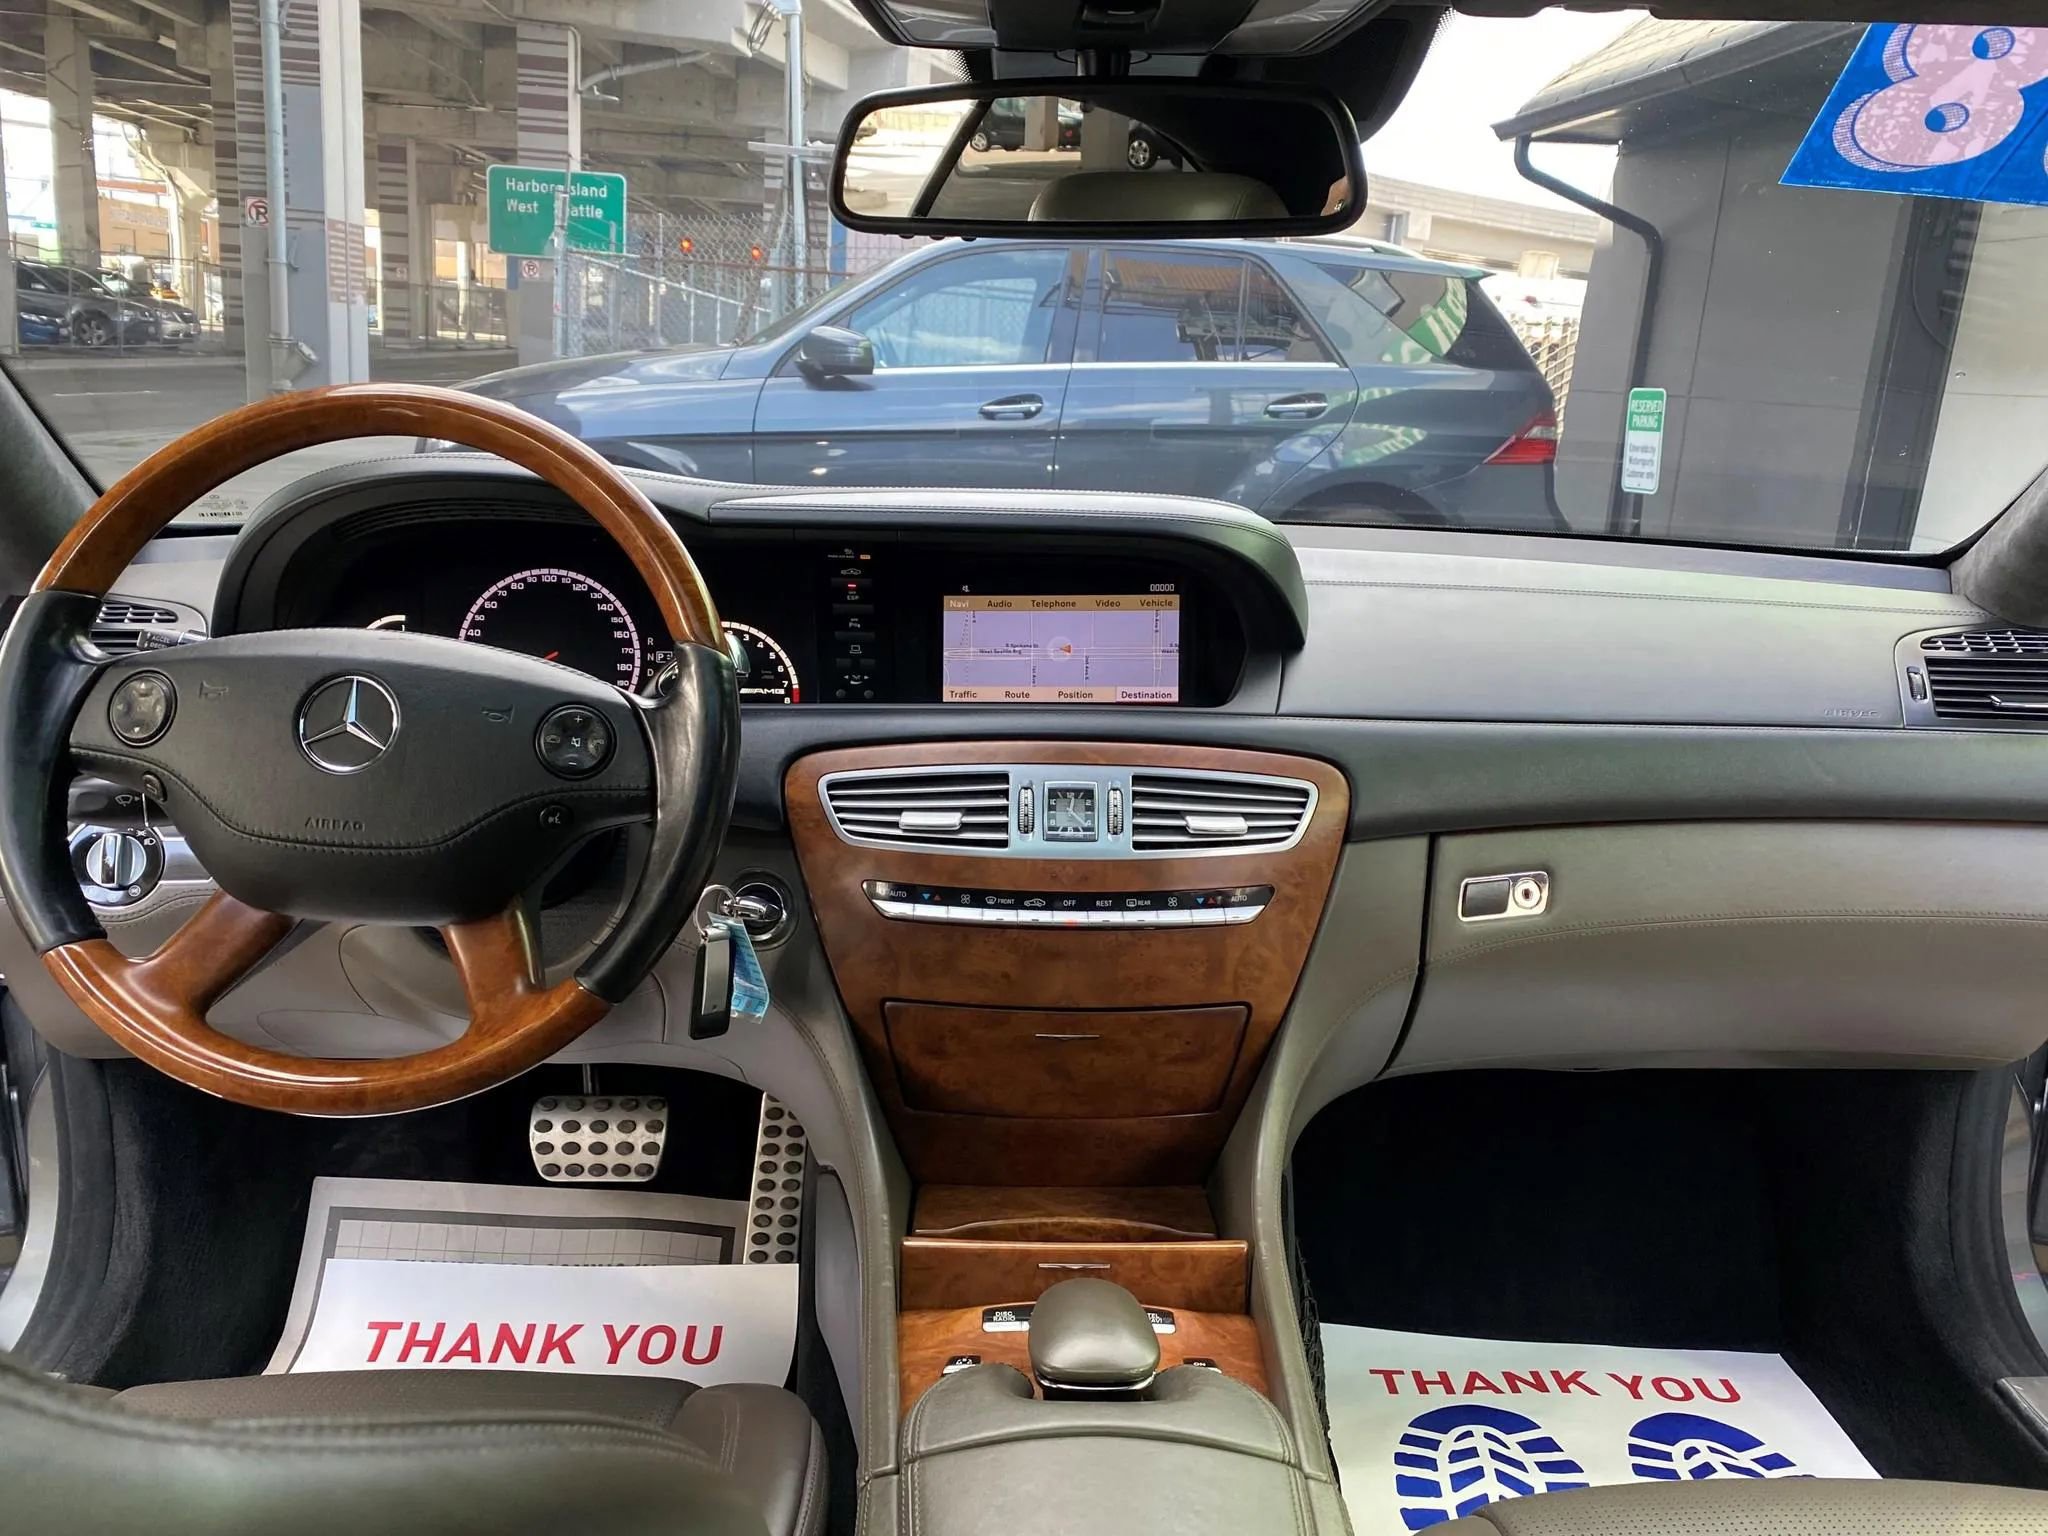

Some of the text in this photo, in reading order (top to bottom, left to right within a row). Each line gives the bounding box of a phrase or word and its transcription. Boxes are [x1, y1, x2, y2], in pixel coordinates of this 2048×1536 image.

[569, 183, 608, 198] sland
[507, 199, 604, 218] West attle
[1630, 400, 1662, 413] RESERVED
[1632, 415, 1658, 428] PARKING
[484, 601, 497, 609] 60
[949, 598, 1173, 610] Navi Audio Telephone Video Vehicle
[467, 629, 481, 637] 40
[613, 631, 630, 639] 160
[151, 635, 170, 644] ACCEL
[647, 637, 654, 646] R
[647, 653, 654, 661] N
[769, 652, 776, 660] 5
[616, 663, 632, 671] 180
[777, 665, 784, 673] 6
[647, 669, 654, 677] D
[782, 680, 789, 688] 7
[949, 690, 1173, 699] Traffic Route Position Destination
[305, 816, 366, 832] AIRBAG
[889, 890, 907, 898] AUTO
[1231, 894, 1248, 902] AUTO
[1063, 899, 1077, 907] OFF
[1096, 899, 1113, 907] REST
[366, 1321, 724, 1366] THANK YOU
[1368, 1368, 1741, 1404] THANK YOU
